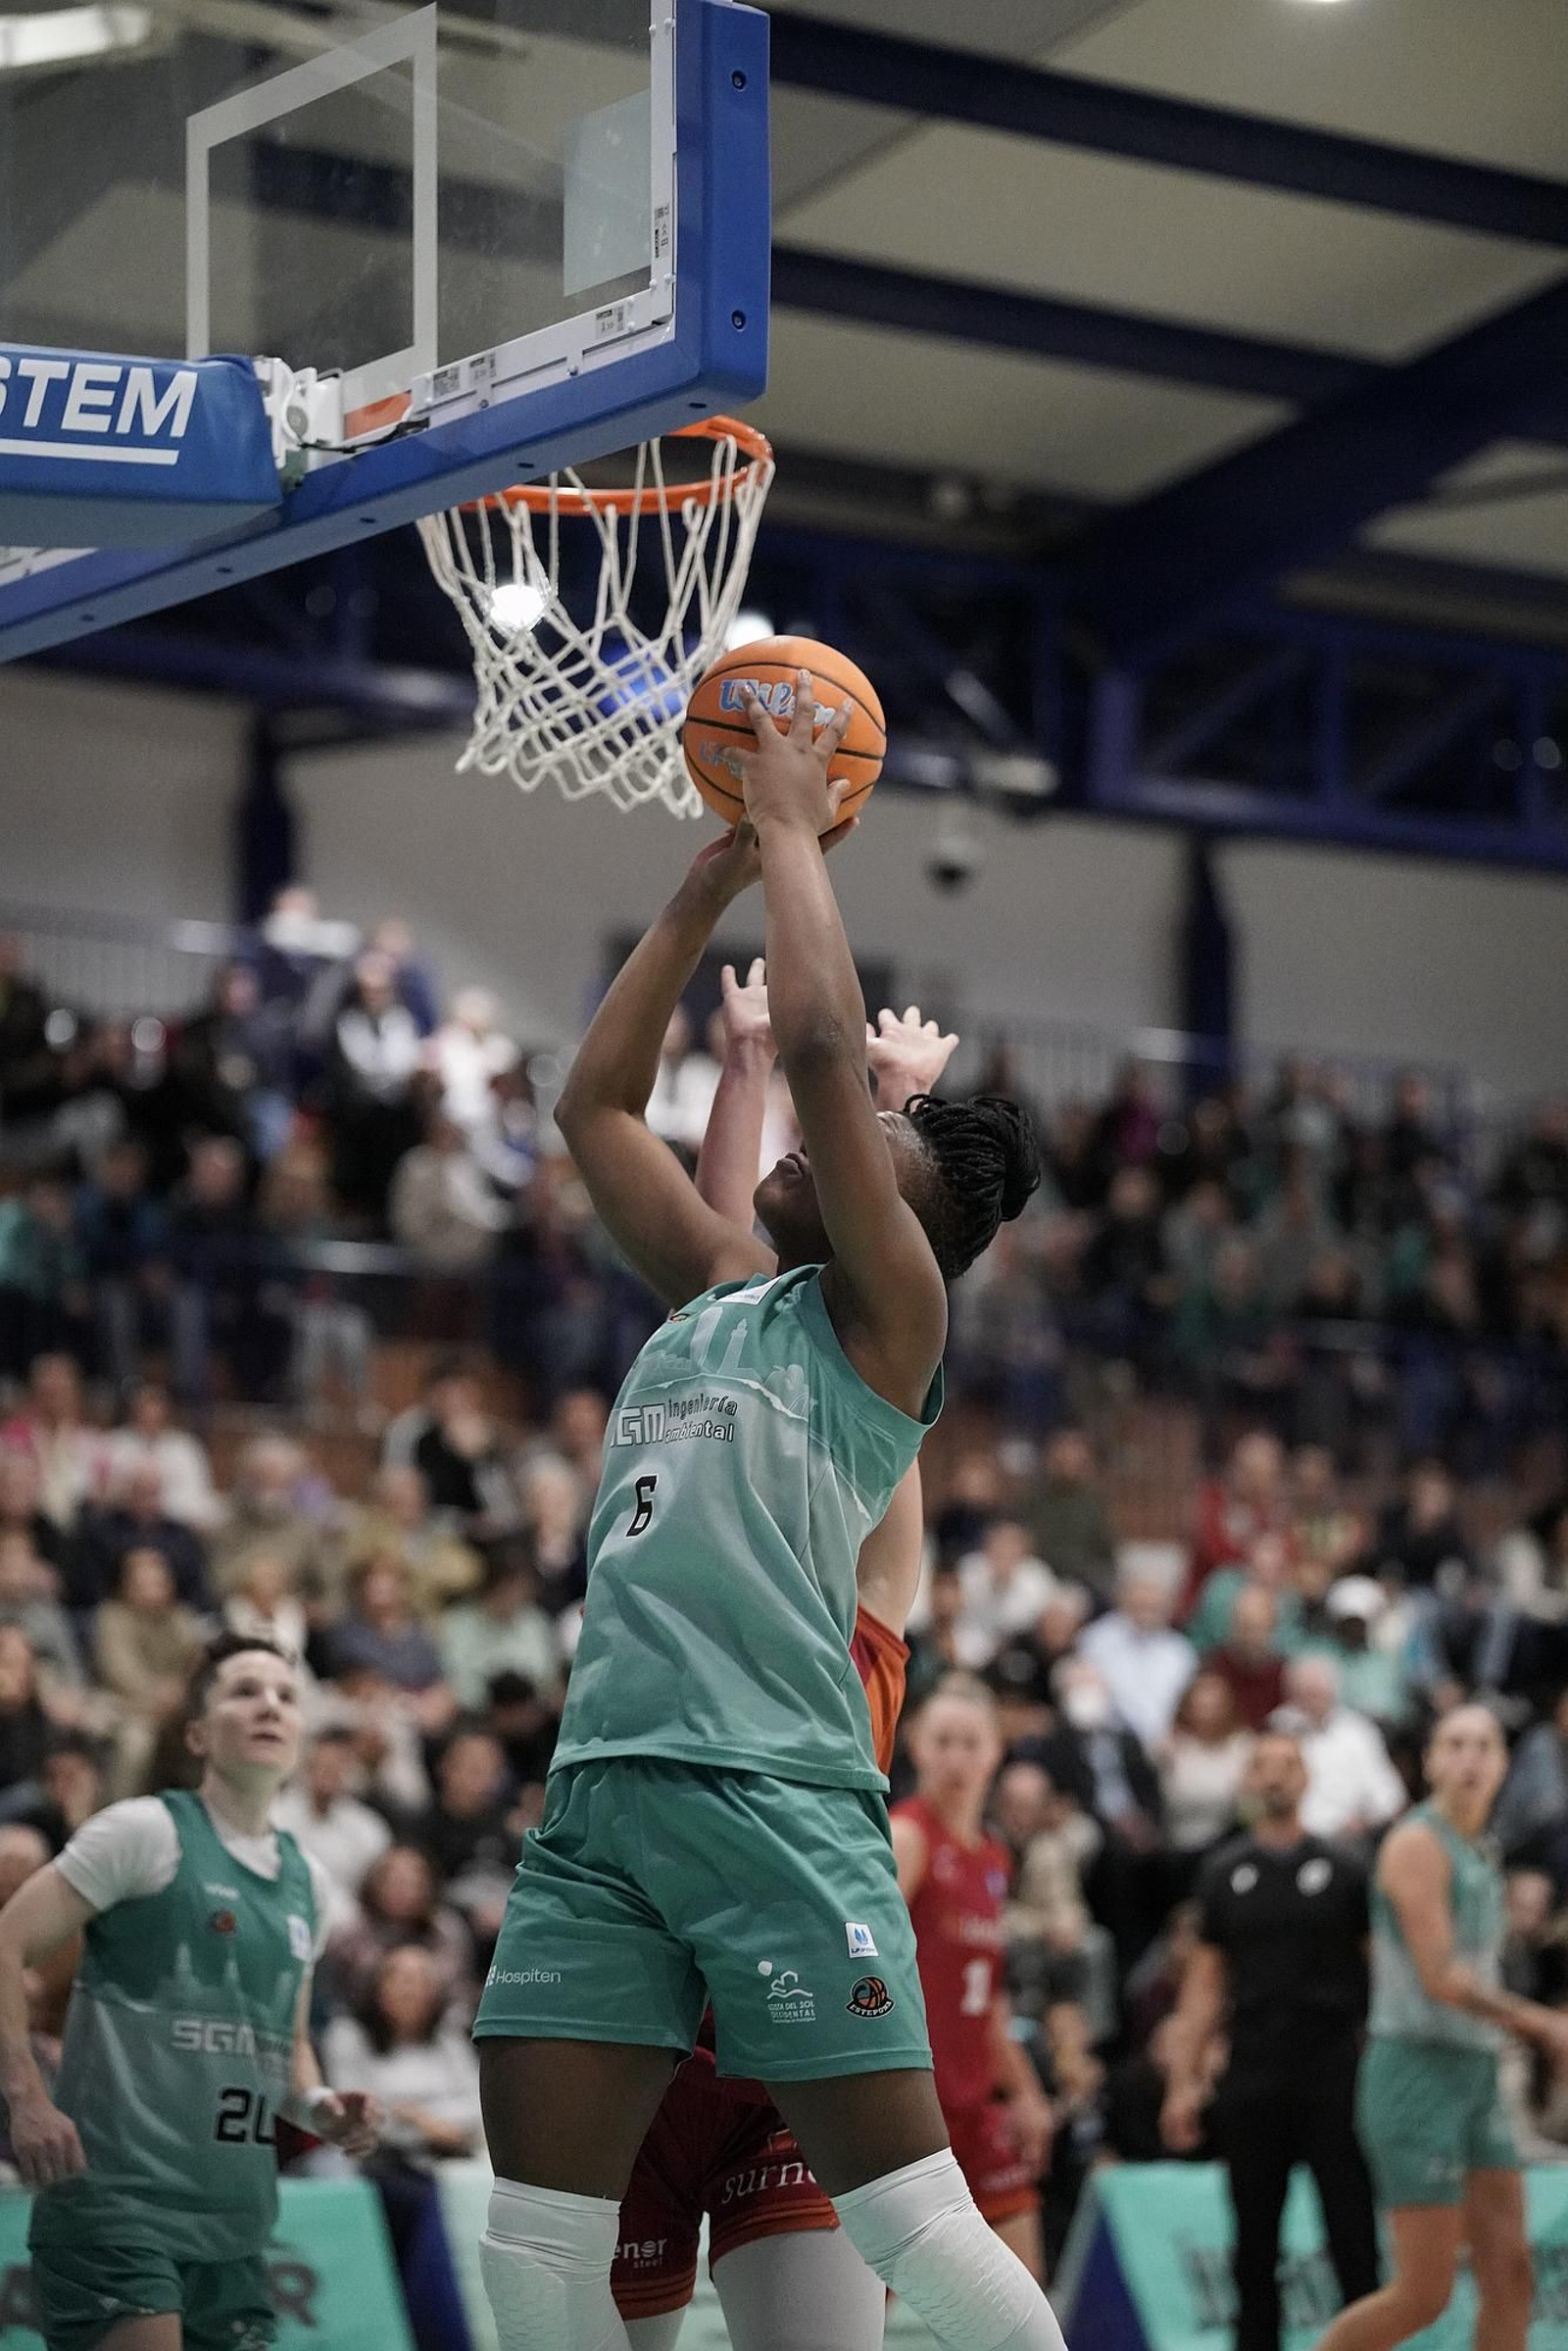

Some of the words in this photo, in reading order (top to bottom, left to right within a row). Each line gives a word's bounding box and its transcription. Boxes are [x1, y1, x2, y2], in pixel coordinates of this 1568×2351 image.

[612, 1403, 666, 1447] GM
[625, 1474, 658, 1538] 6
[496, 1968, 562, 1985] Hospiten
